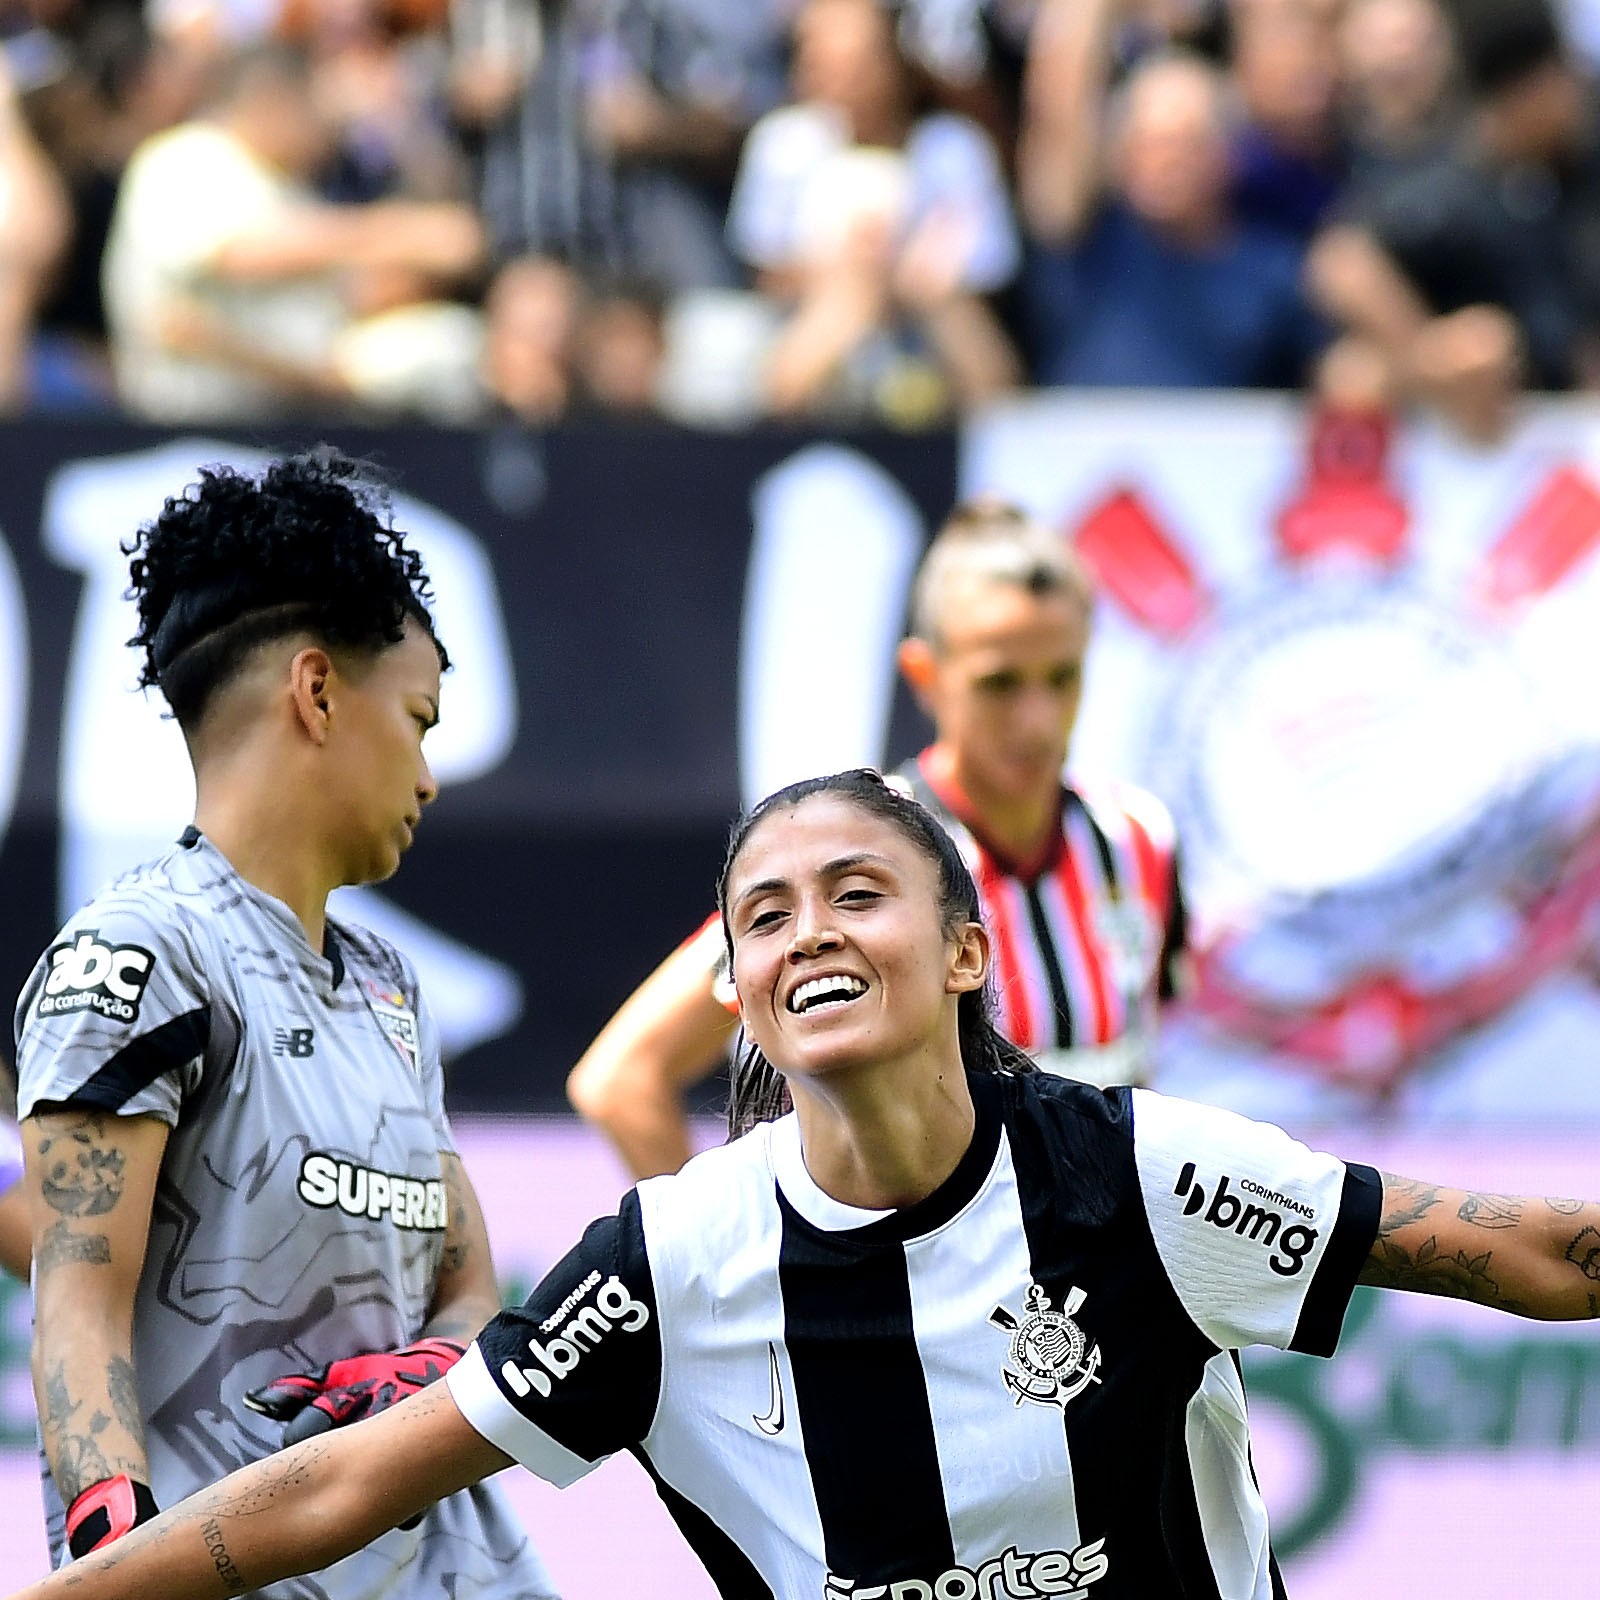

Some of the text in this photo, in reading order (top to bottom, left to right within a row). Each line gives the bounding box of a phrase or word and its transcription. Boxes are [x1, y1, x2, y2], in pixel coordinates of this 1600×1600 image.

[46, 935, 149, 1001] abc
[55, 991, 134, 1019] construção
[1204, 1175, 1319, 1276] bmg
[1240, 1178, 1315, 1220] CORINTHIANS
[528, 1275, 649, 1380] bmg
[539, 1269, 602, 1334] CORINTHIANS
